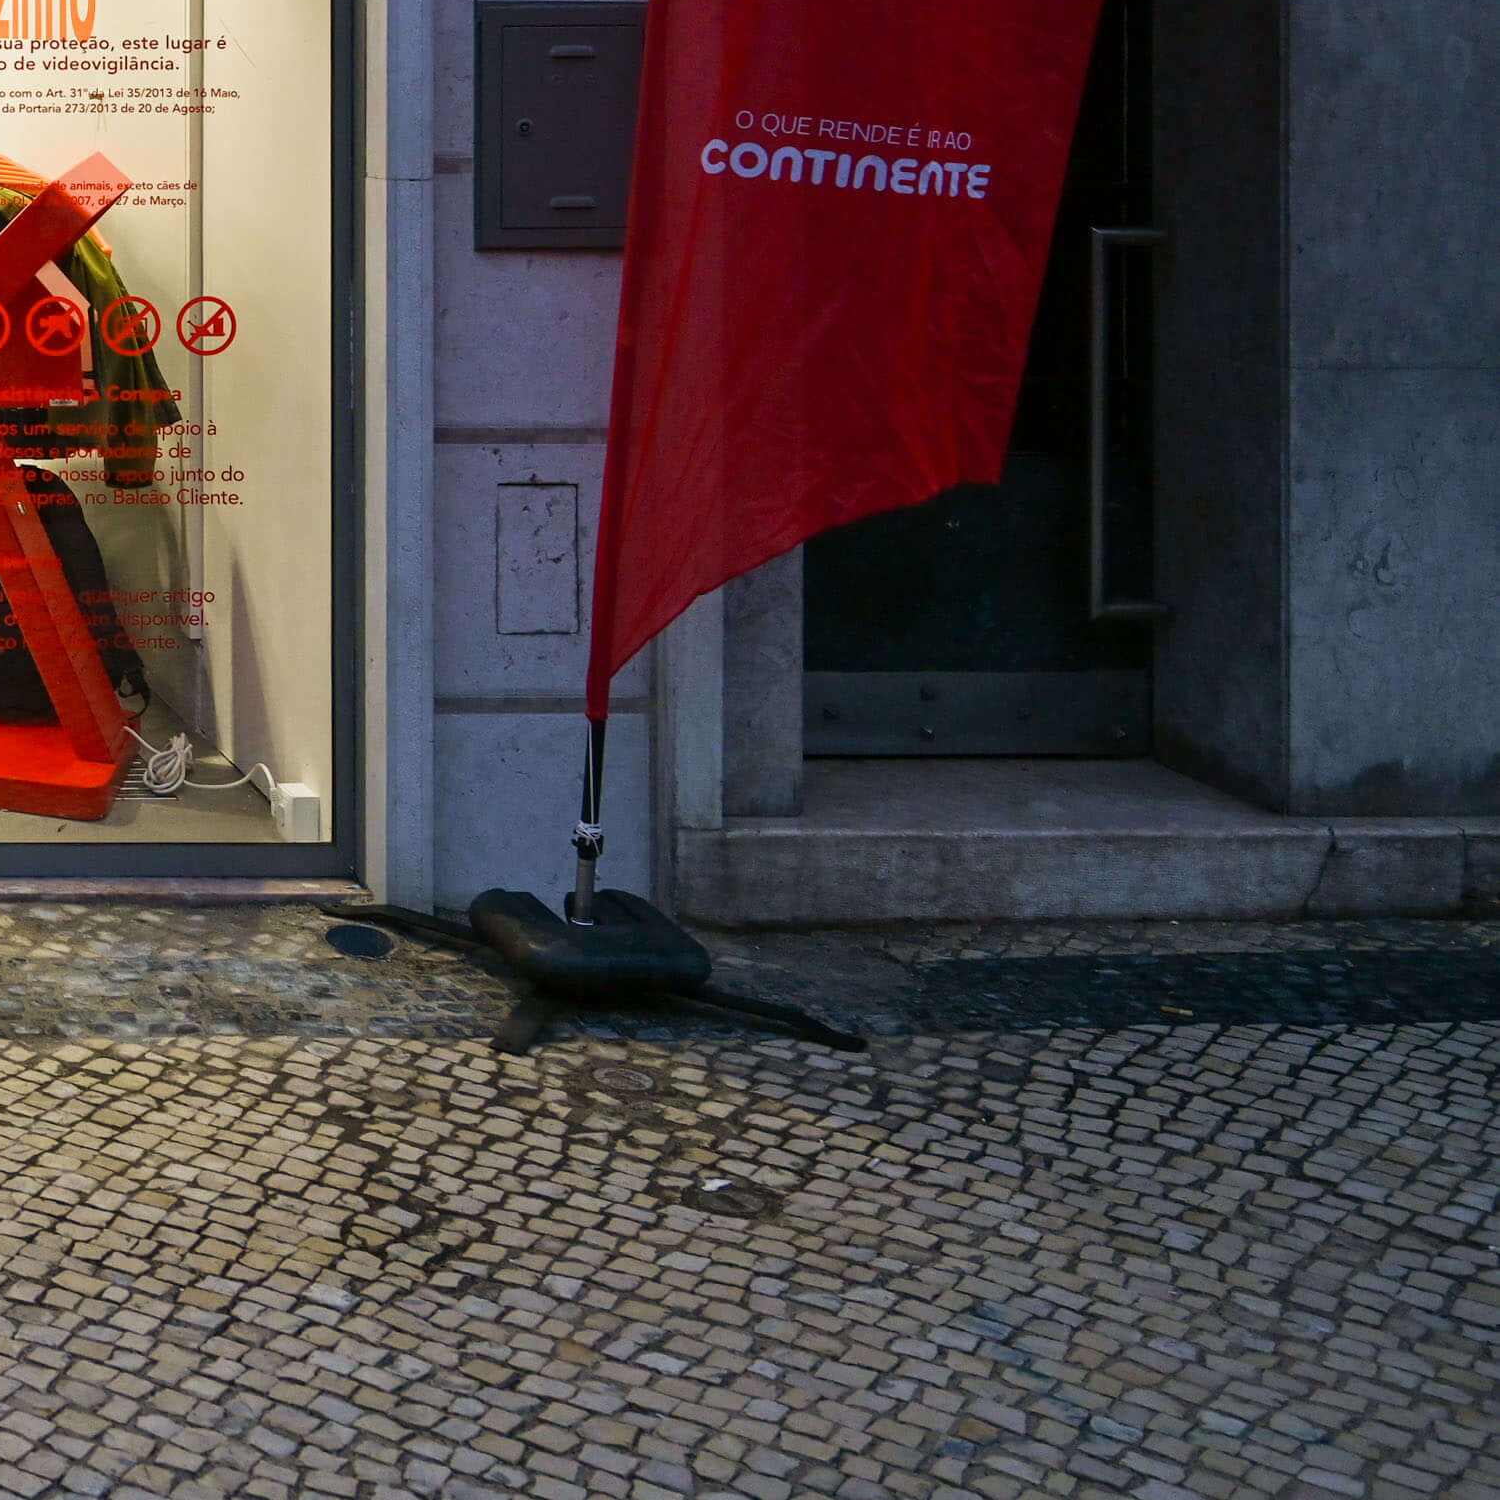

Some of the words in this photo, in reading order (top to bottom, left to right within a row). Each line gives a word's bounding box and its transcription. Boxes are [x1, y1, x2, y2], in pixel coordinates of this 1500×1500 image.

[30, 36, 114, 54] proteção,
[122, 38, 159, 51] este
[166, 36, 211, 54] lugar
[217, 35, 226, 51] é
[14, 56, 34, 71] de
[42, 55, 179, 74] videovigilância.
[9, 91, 32, 99] com
[36, 91, 43, 99] o
[46, 88, 67, 99] Art.
[108, 88, 124, 99] Lei
[127, 88, 173, 100] 35/2013
[176, 88, 190, 99] de
[195, 88, 207, 99] 16
[210, 88, 241, 101] Maio,
[2, 103, 15, 114] da
[19, 103, 62, 114] Portaria
[65, 103, 117, 115] 273/2013
[121, 103, 135, 114] de
[138, 103, 152, 114] 20
[155, 103, 169, 114] de
[172, 103, 215, 117] Agosto;
[735, 110, 754, 129] O
[761, 113, 813, 137] QUE
[818, 119, 903, 145] RENDE
[907, 122, 921, 147] É
[928, 130, 941, 148] IR
[944, 131, 971, 150] AO
[701, 138, 991, 199] CONTINENTE
[70, 180, 113, 192] animais,
[117, 181, 153, 191] exceto
[157, 180, 180, 191] cães
[183, 180, 198, 191] de
[132, 195, 146, 206] de
[150, 195, 187, 208] Março.
[24, 425, 49, 436] um
[207, 420, 217, 436] à
[169, 442, 191, 459] de
[42, 470, 54, 482] o
[59, 470, 110, 482] nosso
[170, 466, 215, 485] junto
[221, 465, 245, 482] do
[85, 493, 107, 505] no
[114, 489, 171, 506] Balcão
[177, 489, 243, 506] Cliente.
[162, 587, 216, 607] artigo
